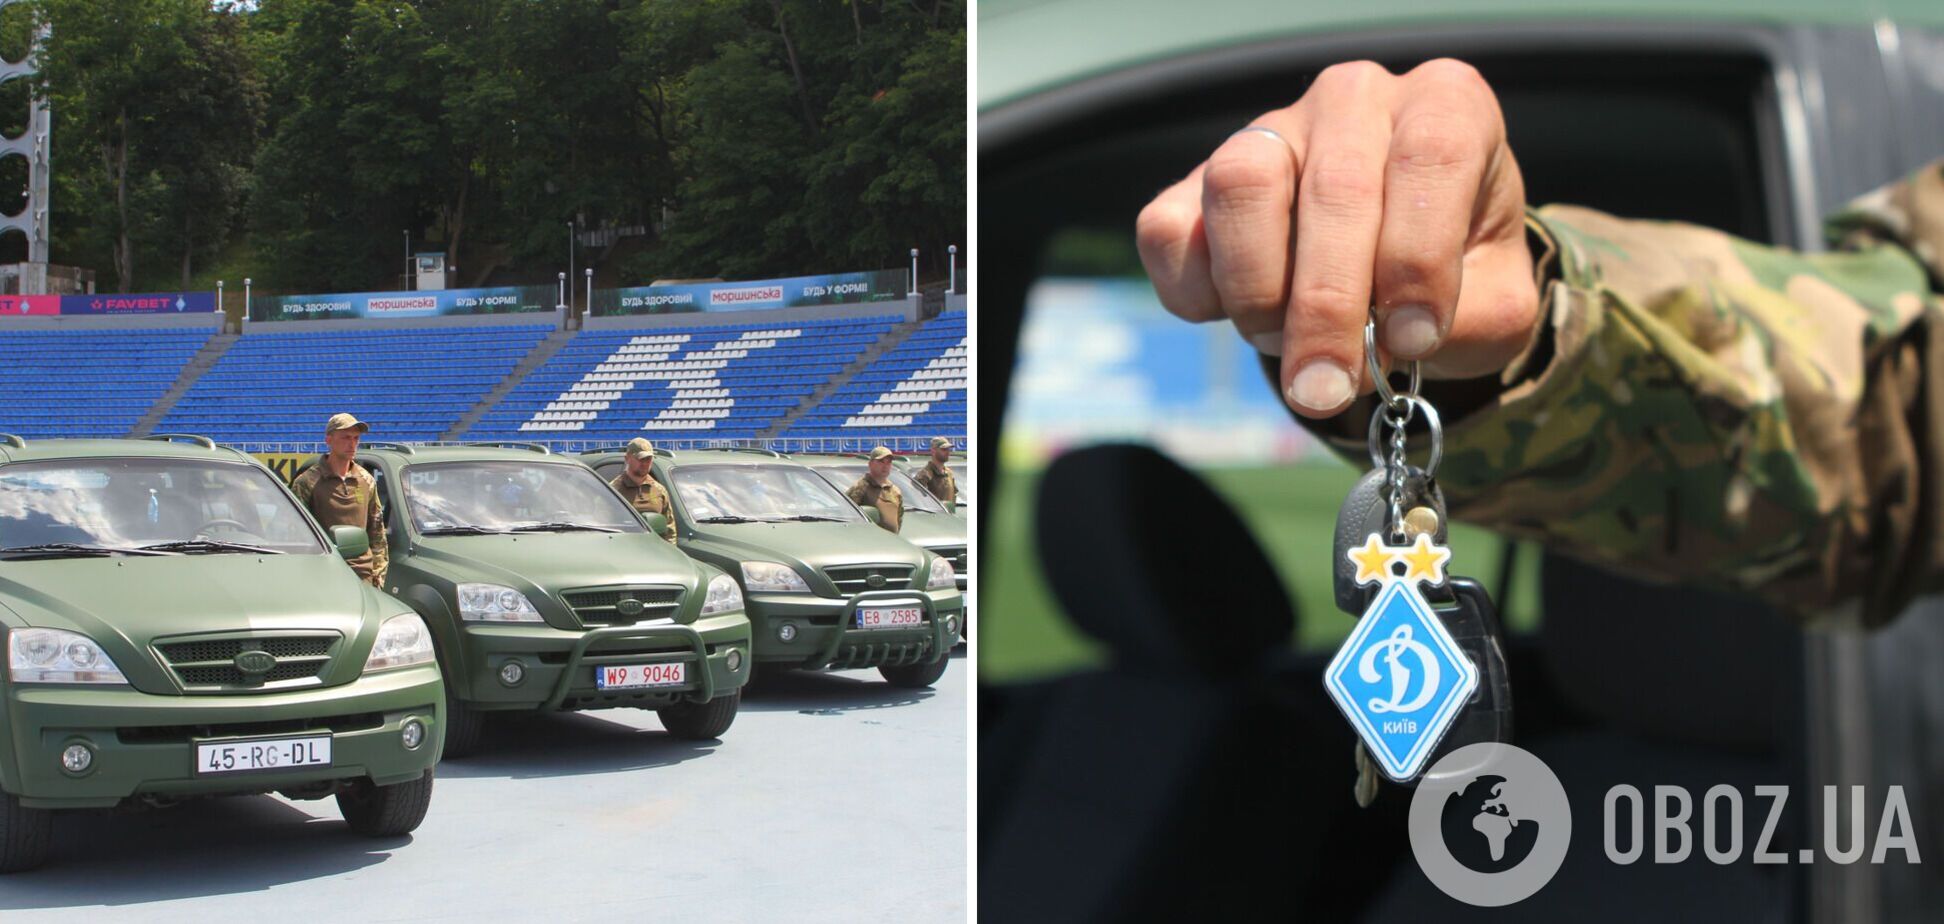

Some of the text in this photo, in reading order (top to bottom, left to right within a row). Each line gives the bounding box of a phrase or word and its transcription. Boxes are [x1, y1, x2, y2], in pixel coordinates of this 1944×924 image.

[712, 289, 781, 303] моршинська
[803, 287, 826, 297] БУДЬ
[827, 285, 833, 295] У
[106, 298, 170, 310] FAVBET
[283, 301, 351, 313] БУДЬ ЗДОРОВИЙ
[370, 298, 435, 312] моршинська
[456, 297, 478, 307] БУДЬ
[622, 294, 693, 307] БУДЬ ЗДОРОВИЙ
[891, 609, 918, 623] 2585
[607, 664, 680, 685] W9 9046
[1382, 718, 1418, 734] КИЇВ
